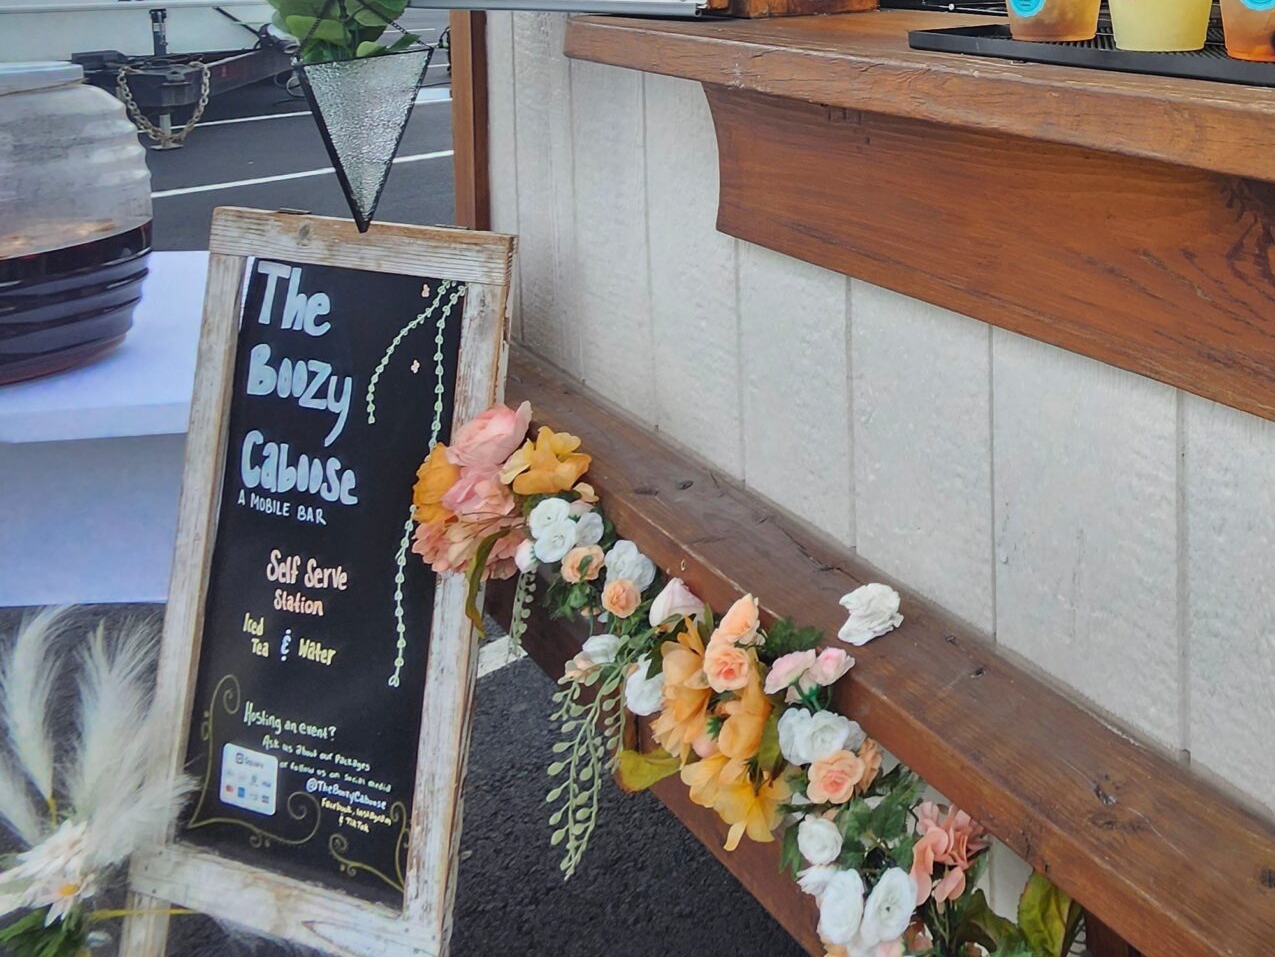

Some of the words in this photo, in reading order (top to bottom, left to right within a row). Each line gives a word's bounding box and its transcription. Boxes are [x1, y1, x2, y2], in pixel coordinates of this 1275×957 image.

[257, 260, 331, 336] The
[237, 489, 246, 505] A
[250, 492, 291, 516] MOBILE
[297, 505, 327, 525] BAR
[266, 549, 301, 584] Self
[304, 557, 349, 590] Serve
[273, 588, 324, 616] Station
[242, 612, 265, 636] Iced
[251, 638, 269, 657] Tea
[298, 638, 336, 665] Water
[243, 700, 282, 735] Hosting
[284, 720, 298, 734] an
[298, 722, 337, 742] event?
[262, 734, 279, 750] Ask
[282, 743, 294, 753] us
